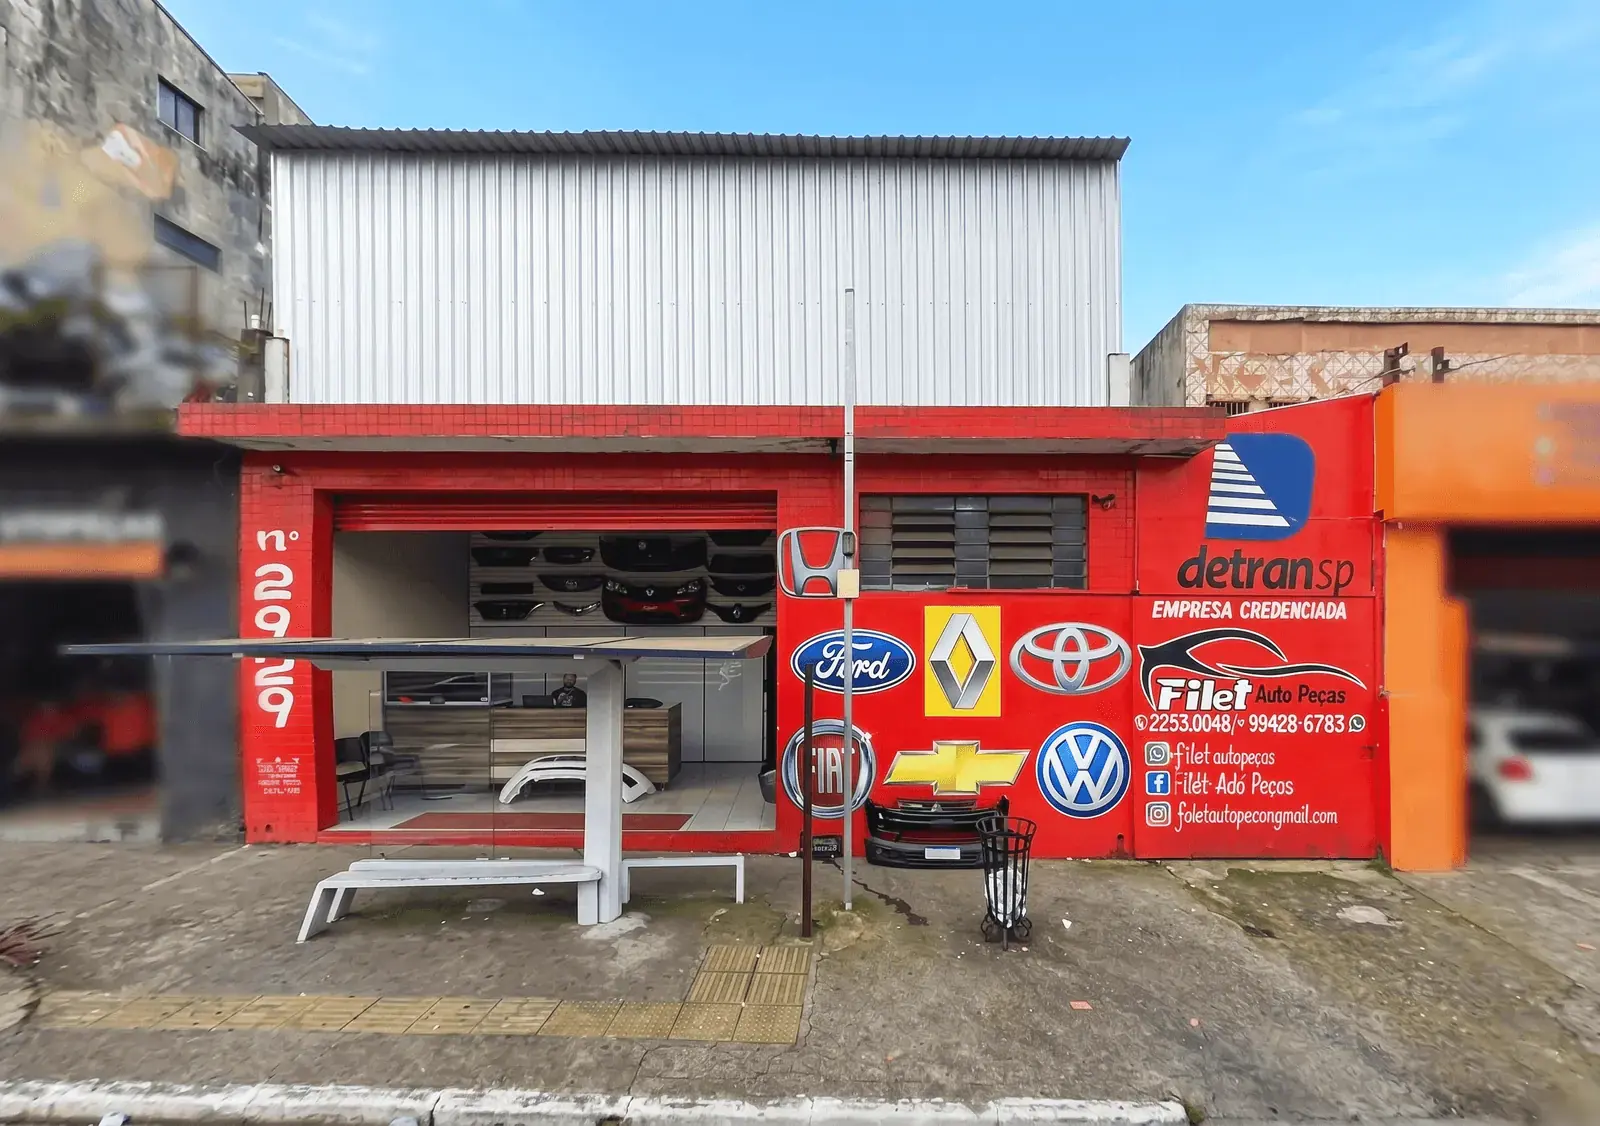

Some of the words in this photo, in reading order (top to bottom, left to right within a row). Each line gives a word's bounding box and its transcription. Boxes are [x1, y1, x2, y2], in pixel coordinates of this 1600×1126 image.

[1151, 600, 1233, 620] EMPRESA
[1239, 601, 1347, 620] CREDENCIADA
[1155, 677, 1253, 711] Filet
[1255, 685, 1292, 704] Auto
[1298, 684, 1346, 706] Peças
[1248, 714, 1345, 733] 99428-6783
[1174, 741, 1210, 770] filet
[1213, 744, 1275, 771] autopeças
